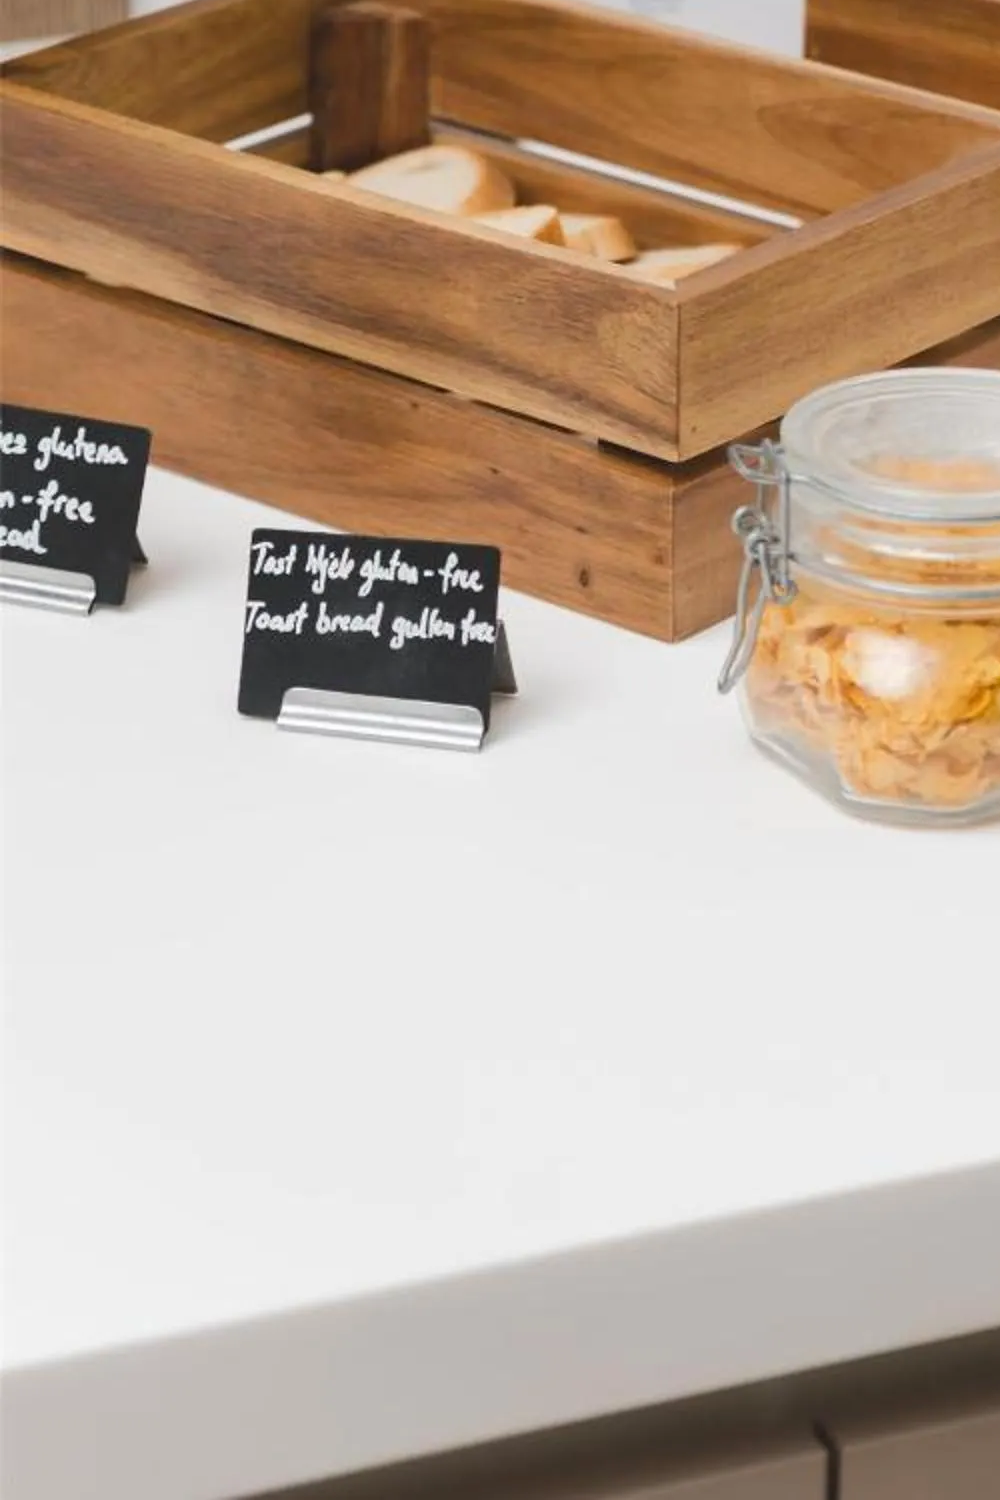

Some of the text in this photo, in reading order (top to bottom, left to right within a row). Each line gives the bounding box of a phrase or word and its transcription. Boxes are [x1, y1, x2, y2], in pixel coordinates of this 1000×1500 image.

[0, 425, 128, 471] ez glutena
[246, 601, 308, 635] Toast
[315, 601, 384, 638] bread
[461, 607, 497, 647] free
